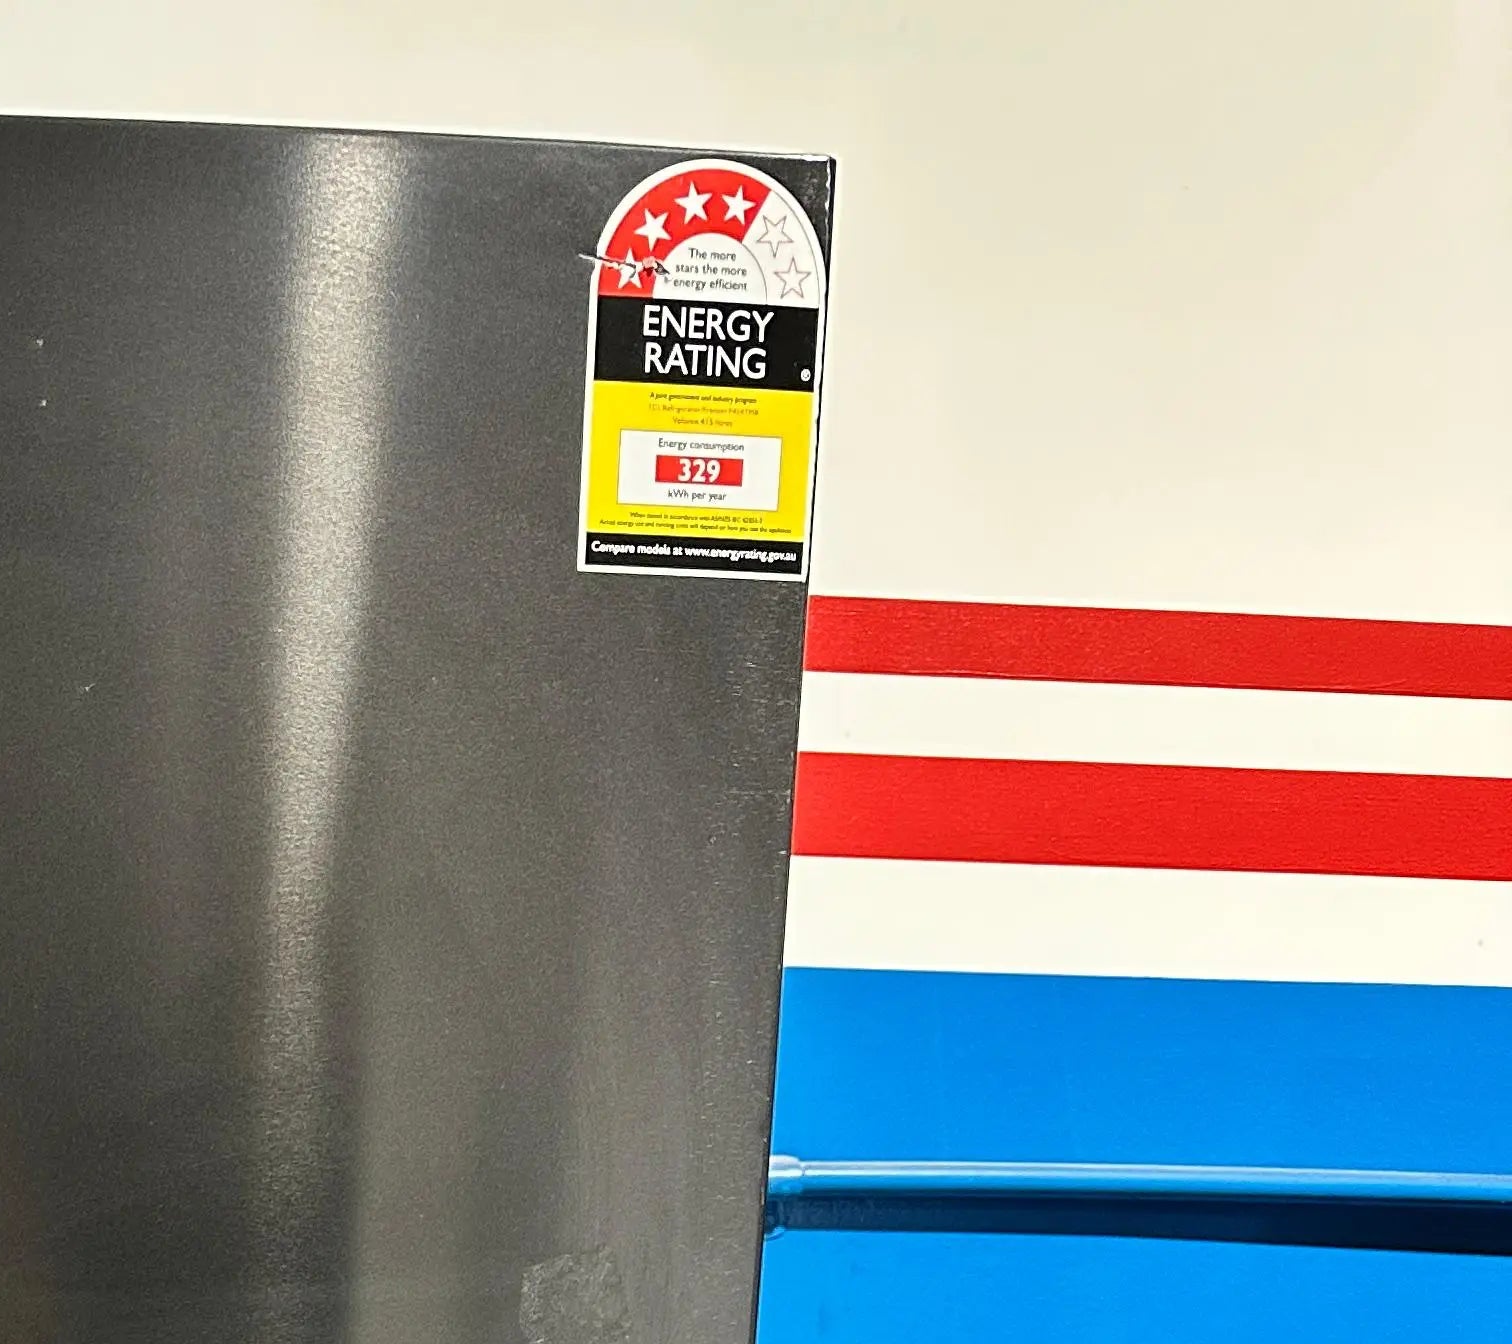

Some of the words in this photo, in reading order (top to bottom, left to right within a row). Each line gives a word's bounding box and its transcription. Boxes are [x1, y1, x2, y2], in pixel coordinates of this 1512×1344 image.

[688, 247, 707, 260] The
[711, 251, 737, 262] more
[675, 264, 699, 274] stars
[702, 262, 718, 275] the
[721, 267, 747, 277] more
[673, 278, 706, 291] energy
[709, 278, 748, 291] efficient
[642, 304, 775, 343] ENERGY
[644, 342, 768, 380] RATING
[658, 437, 688, 451] Energy
[689, 441, 745, 453] consumption
[677, 457, 721, 484] 329
[691, 492, 707, 502] per
[708, 492, 728, 503] year
[591, 540, 636, 556] Compare
[673, 546, 683, 555] at
